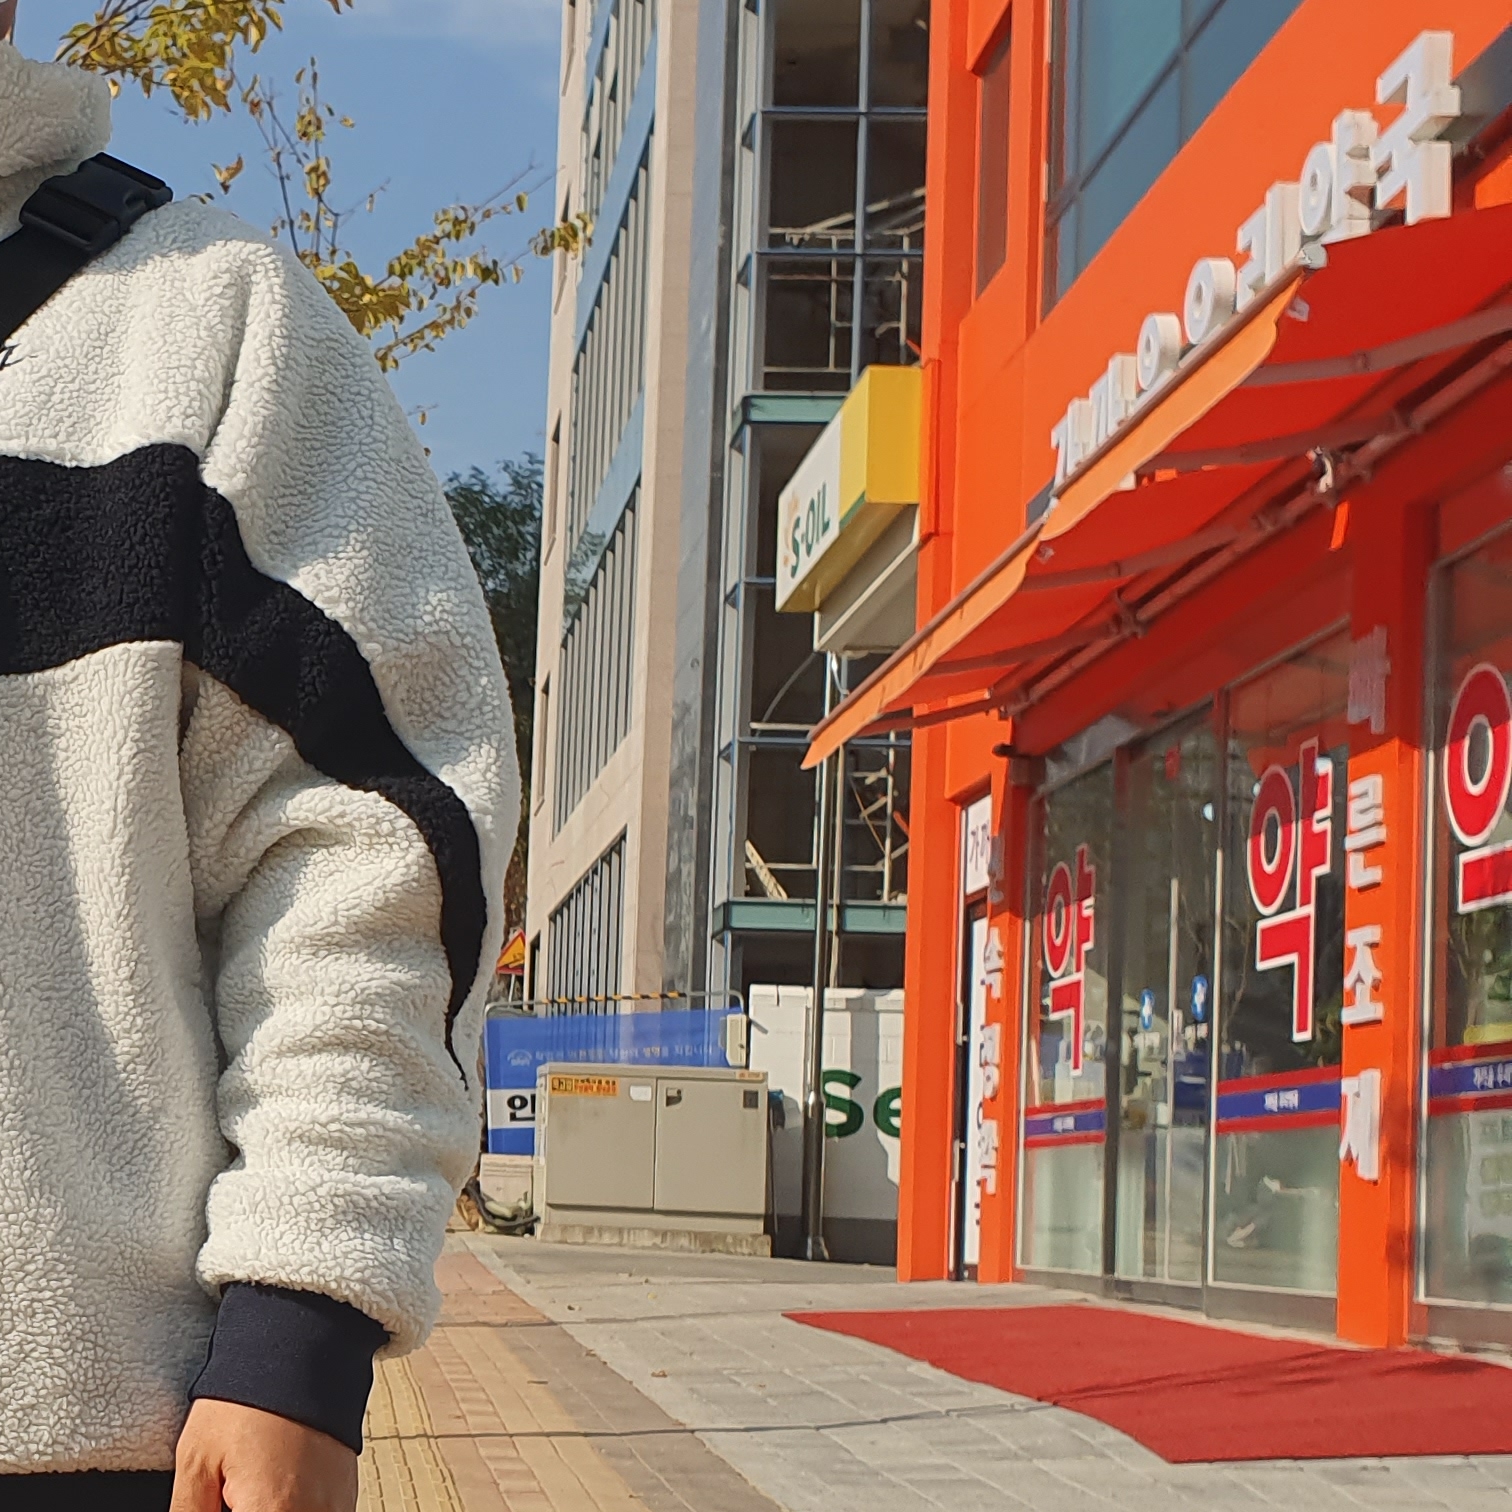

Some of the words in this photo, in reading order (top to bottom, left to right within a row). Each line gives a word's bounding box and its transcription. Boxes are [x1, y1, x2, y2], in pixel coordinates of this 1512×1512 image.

[790, 480, 830, 579] S-OIL
[1043, 843, 1096, 1076] 약
[1246, 734, 1335, 1043] 약
